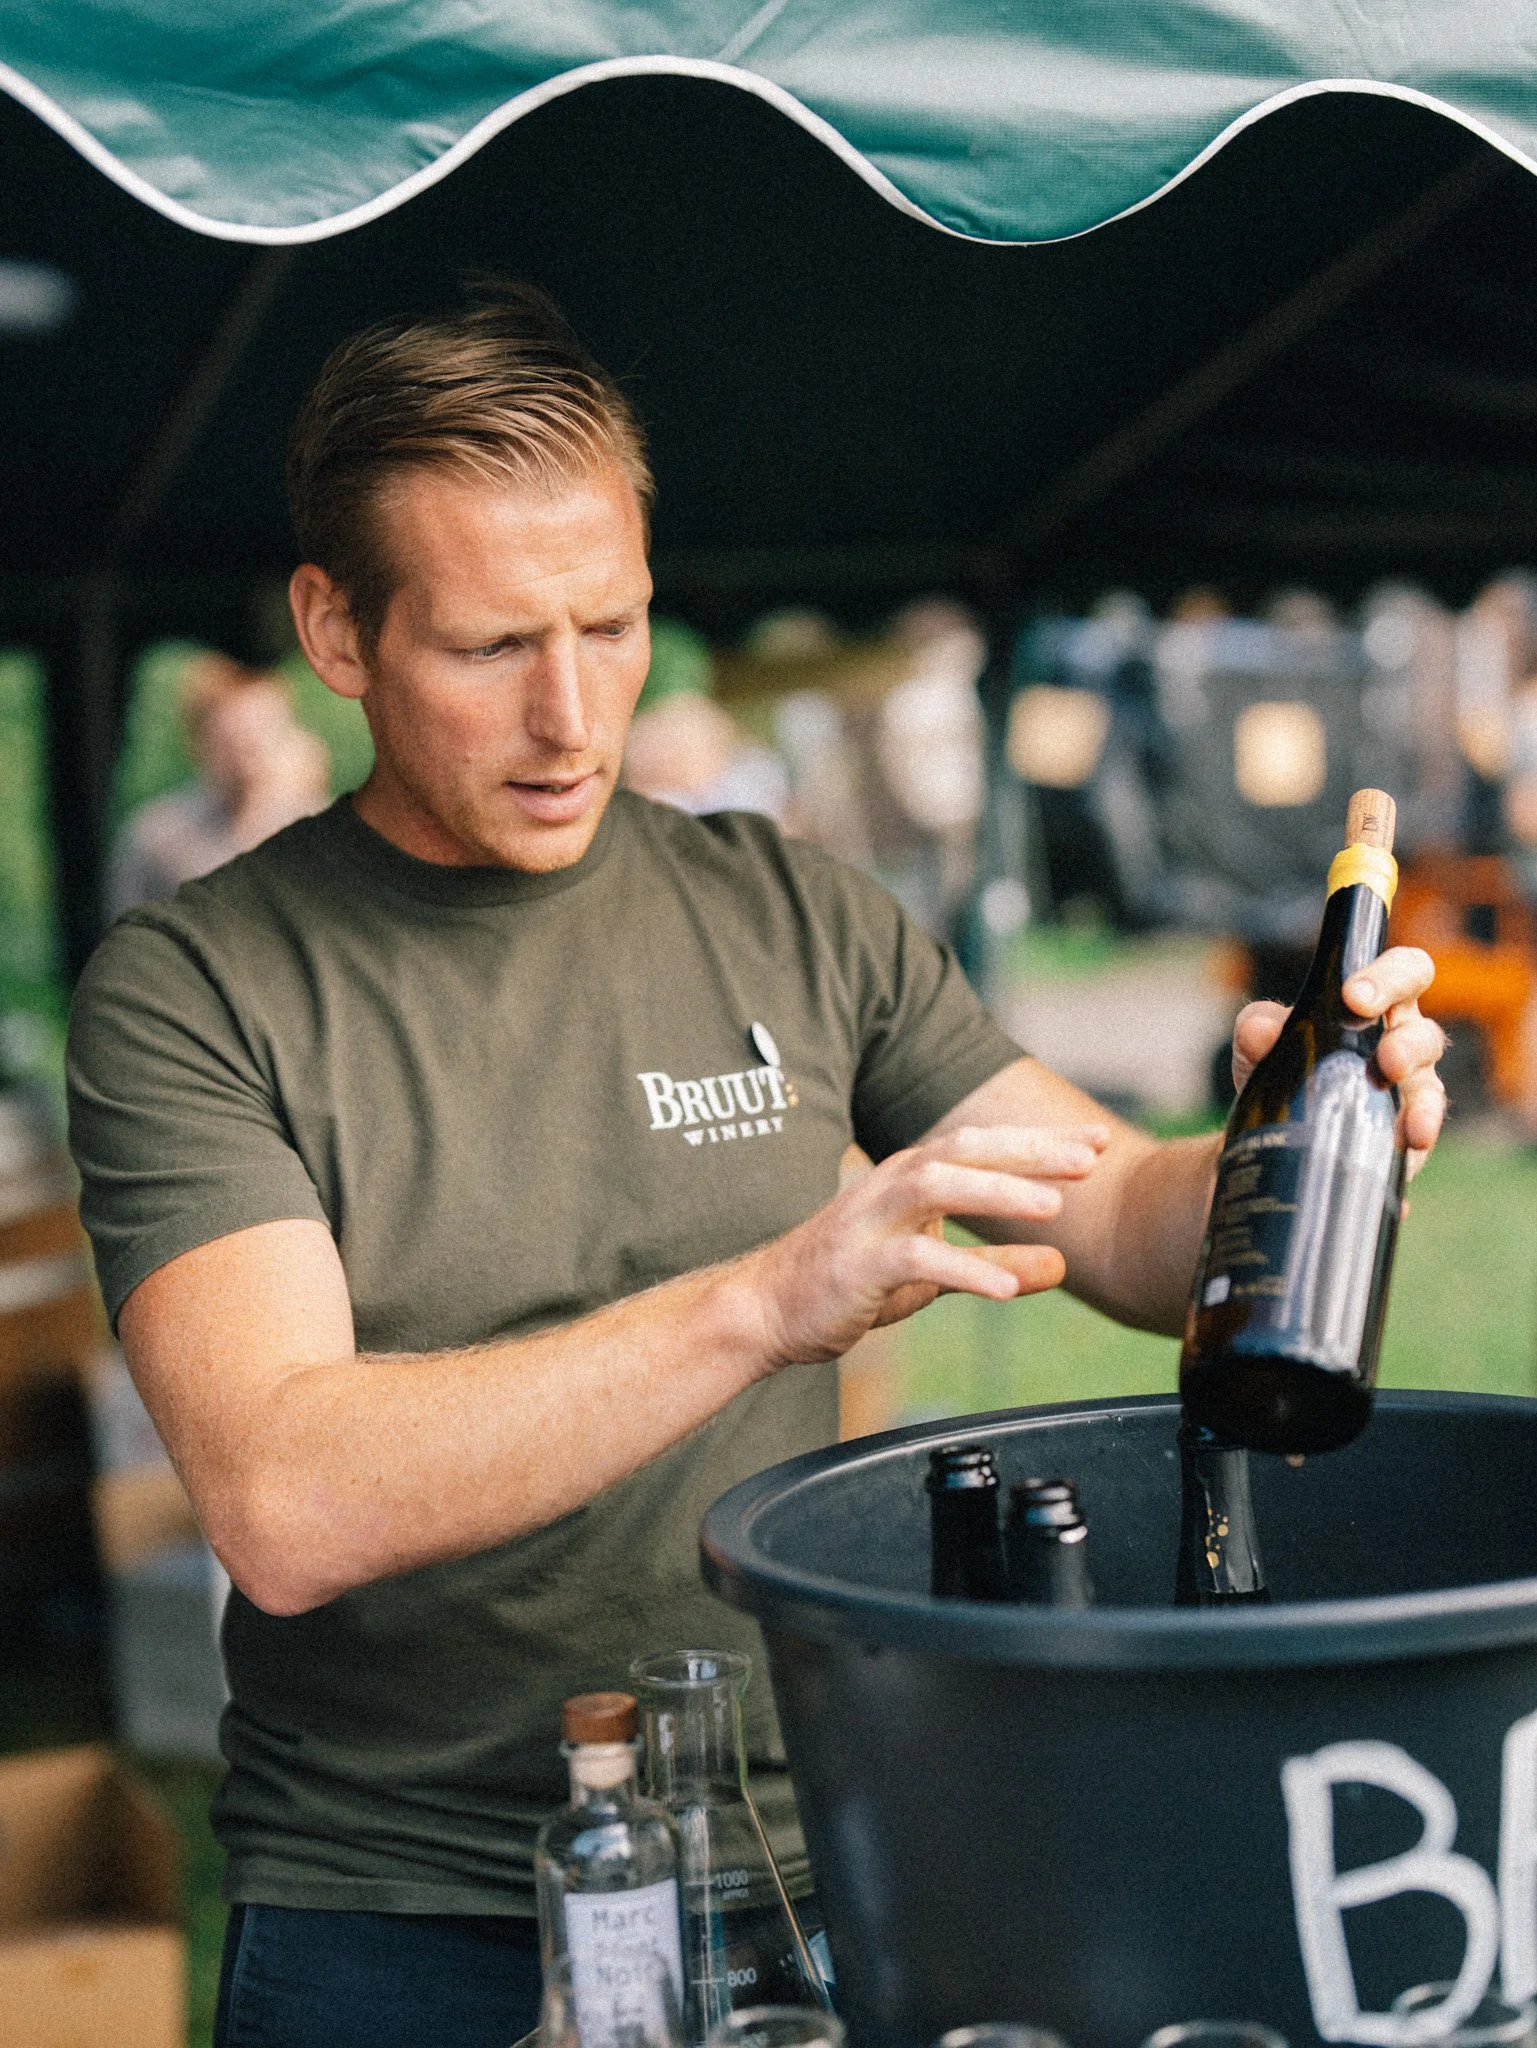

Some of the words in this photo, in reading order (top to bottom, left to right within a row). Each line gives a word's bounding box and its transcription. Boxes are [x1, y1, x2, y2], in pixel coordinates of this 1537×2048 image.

[682, 1116, 784, 1146] WINERY
[714, 1869, 749, 1889] 1000
[591, 1904, 655, 1934] Marc
[726, 1967, 758, 1987] 800
